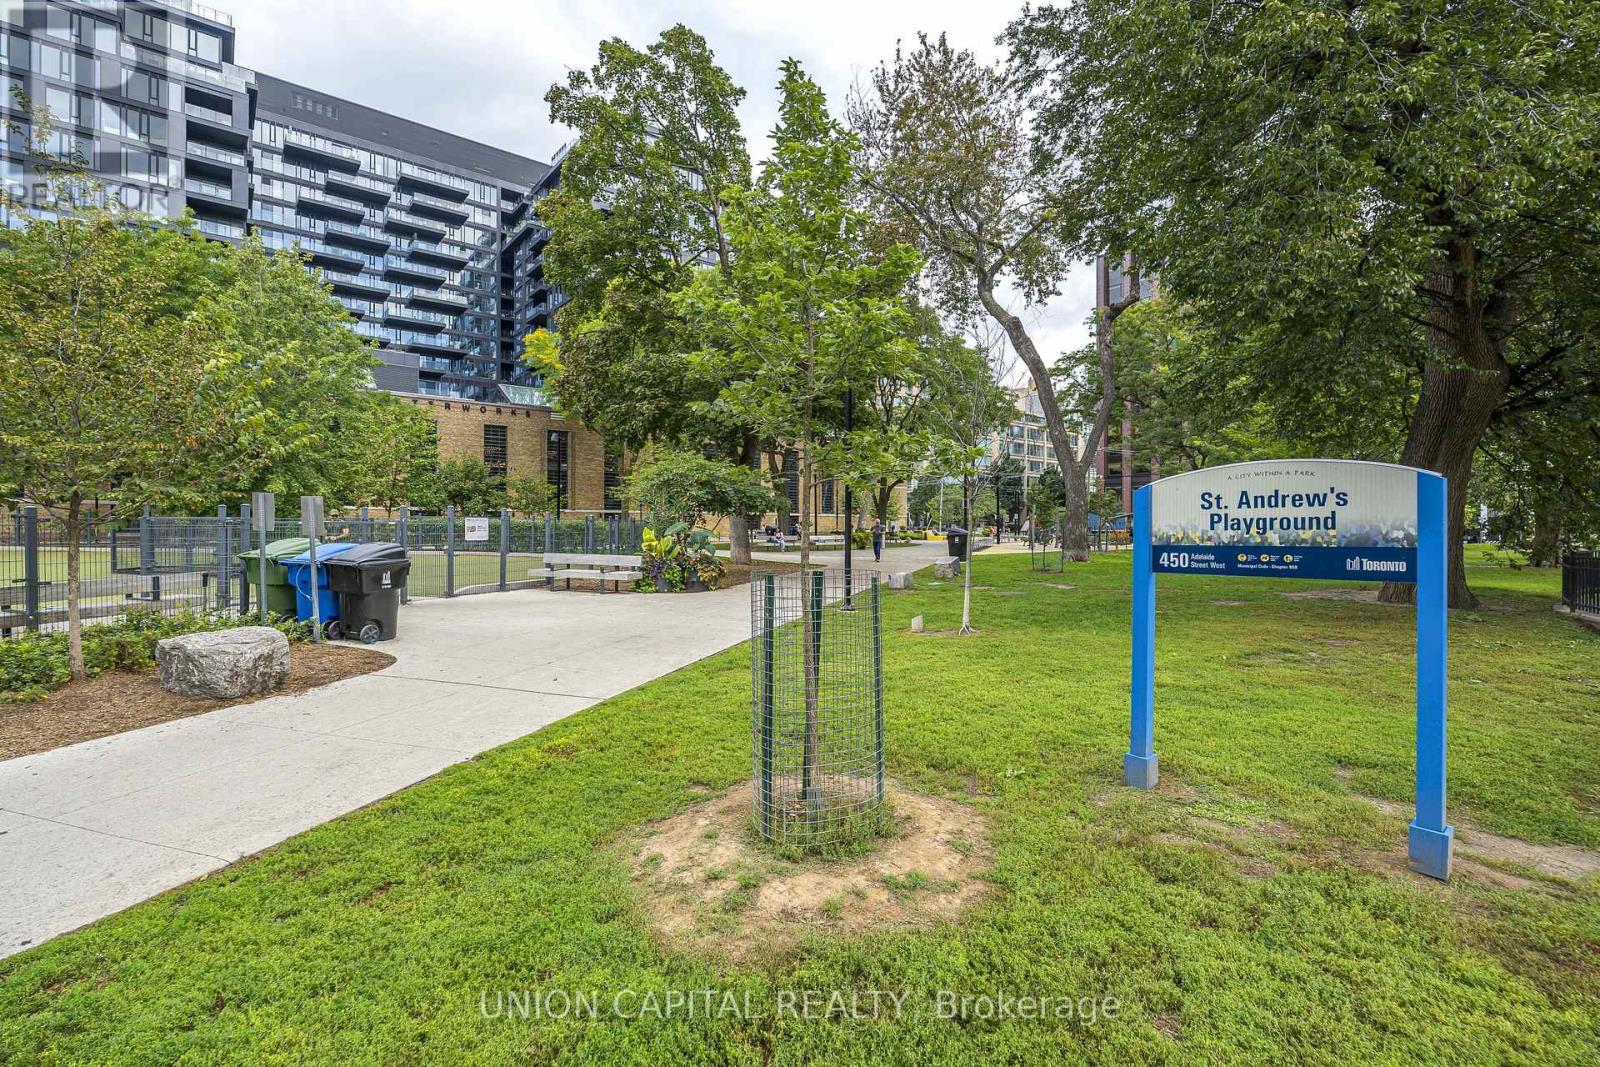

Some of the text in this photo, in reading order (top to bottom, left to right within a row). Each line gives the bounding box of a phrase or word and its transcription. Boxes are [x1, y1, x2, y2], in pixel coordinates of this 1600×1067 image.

[1200, 486, 1348, 510] St. Andrew's
[1209, 511, 1336, 535] Playground
[1160, 552, 1189, 568] 450
[1210, 561, 1226, 569] West
[1361, 558, 1407, 572] TORONTO
